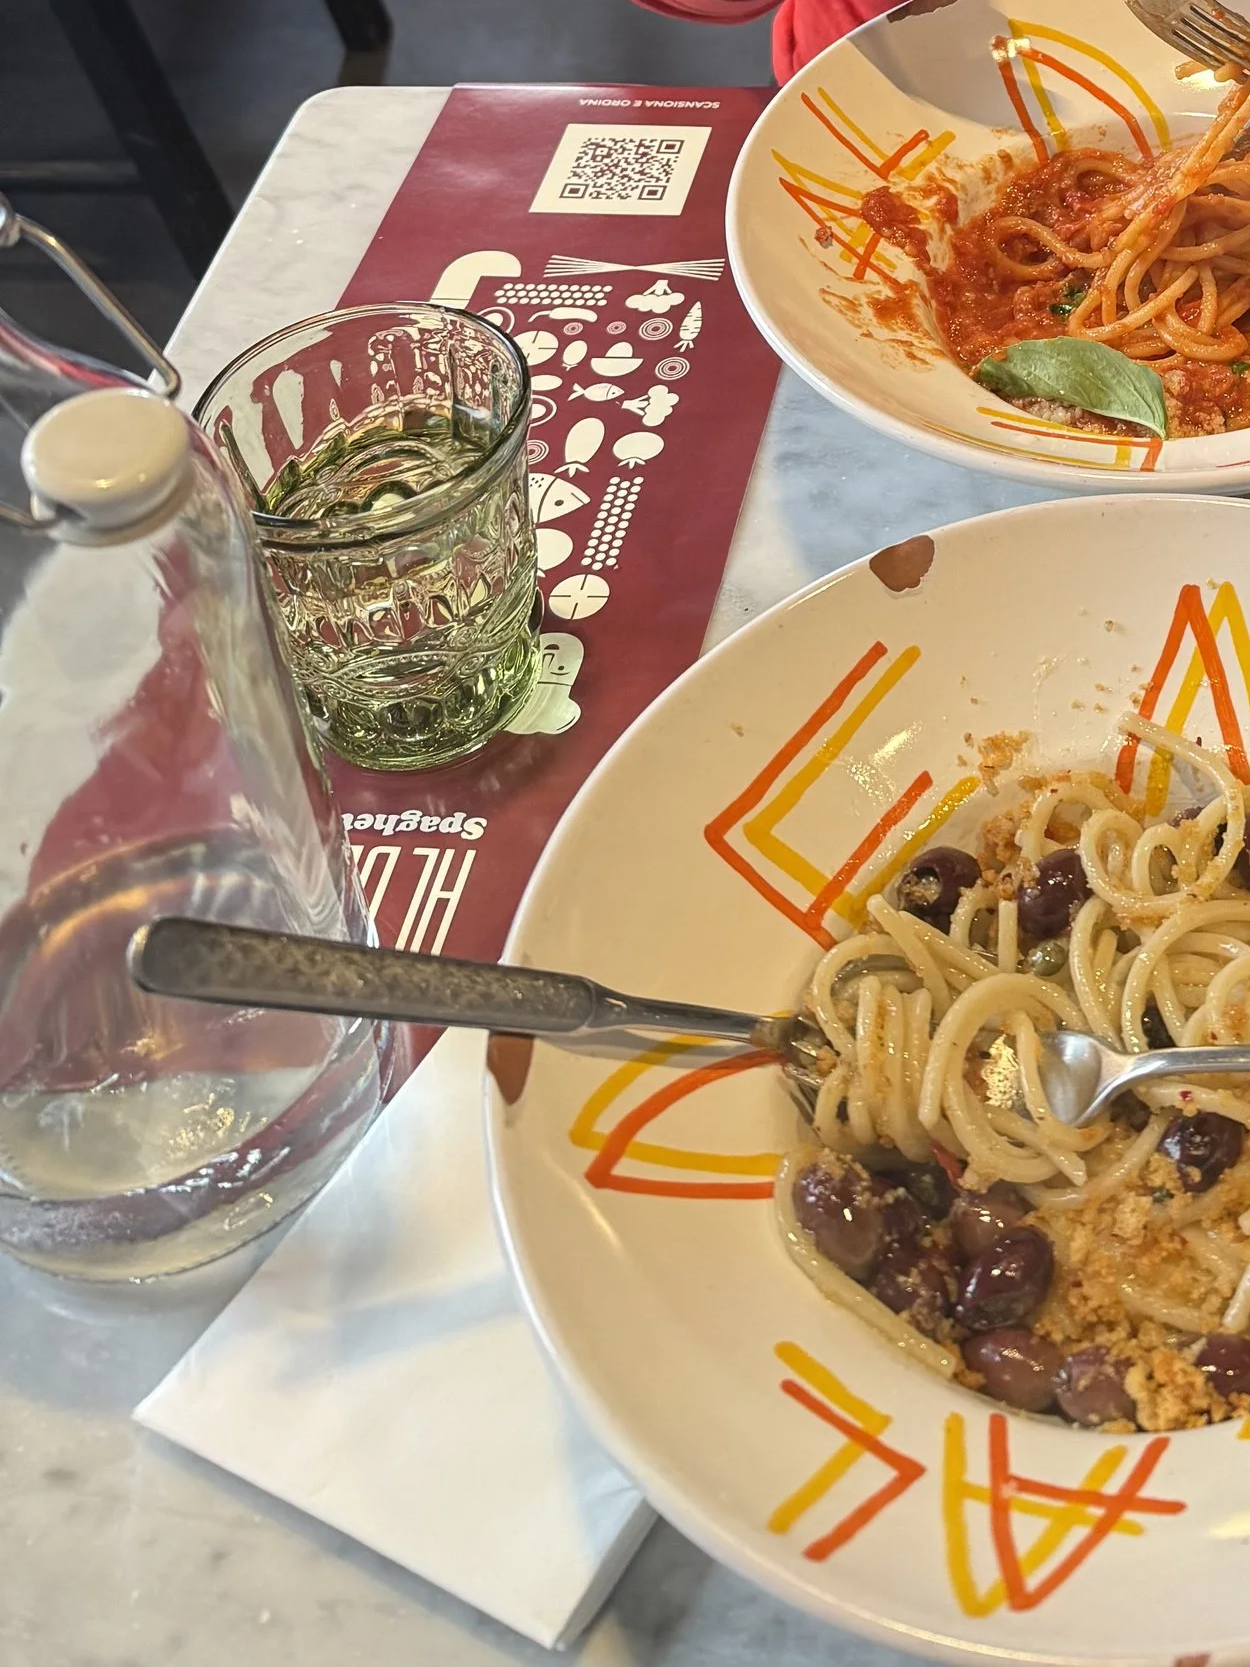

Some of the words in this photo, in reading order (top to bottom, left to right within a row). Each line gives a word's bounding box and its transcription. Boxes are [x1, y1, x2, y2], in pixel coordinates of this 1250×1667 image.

[579, 98, 632, 108] ORDINA
[633, 99, 642, 108] E
[645, 99, 721, 109] SCANSIONA
[341, 810, 488, 840] Spaghet
